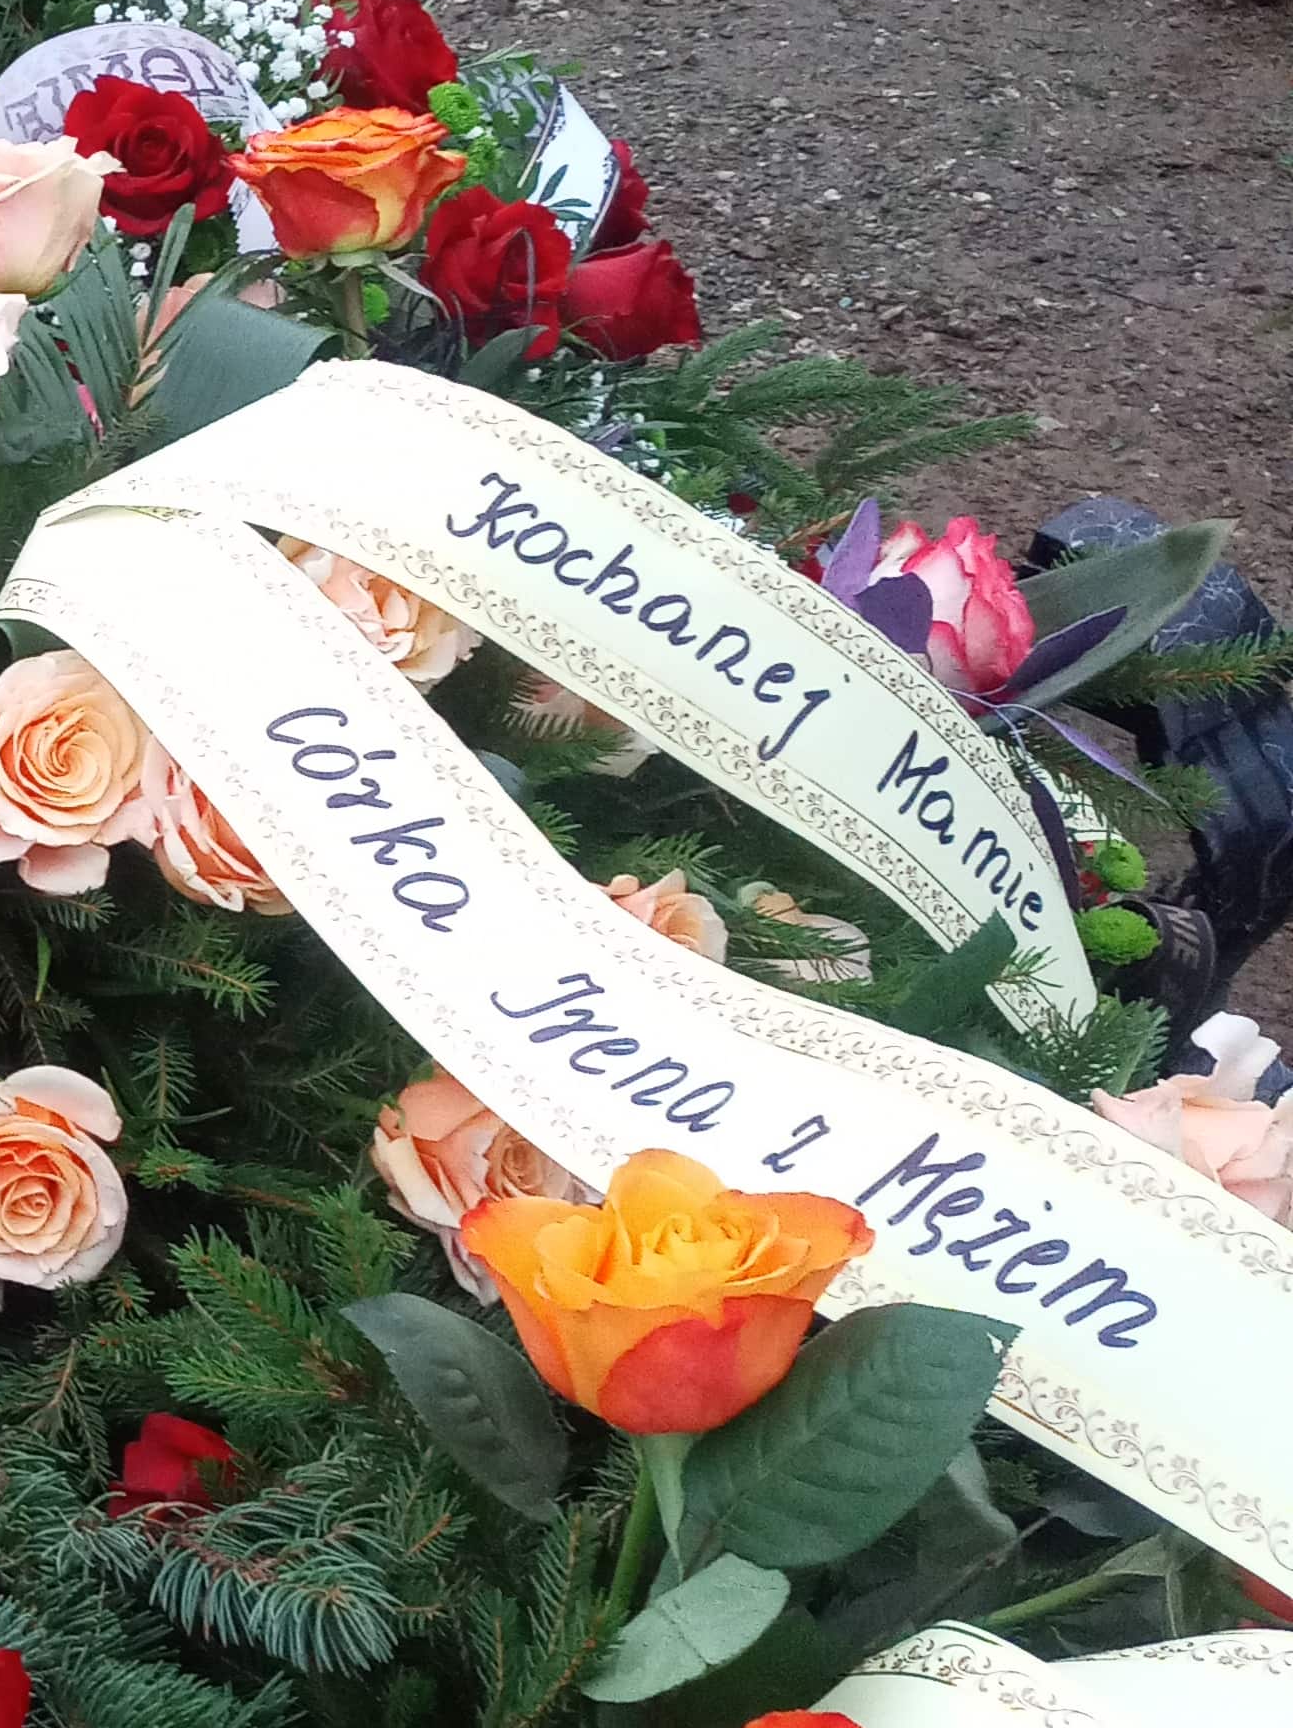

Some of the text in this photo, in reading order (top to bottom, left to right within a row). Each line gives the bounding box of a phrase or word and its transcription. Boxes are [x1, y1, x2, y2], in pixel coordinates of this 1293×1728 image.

[446, 472, 1045, 934] Kochanej Mamie
[265, 703, 1160, 1351] Córka Irena z Mężem
